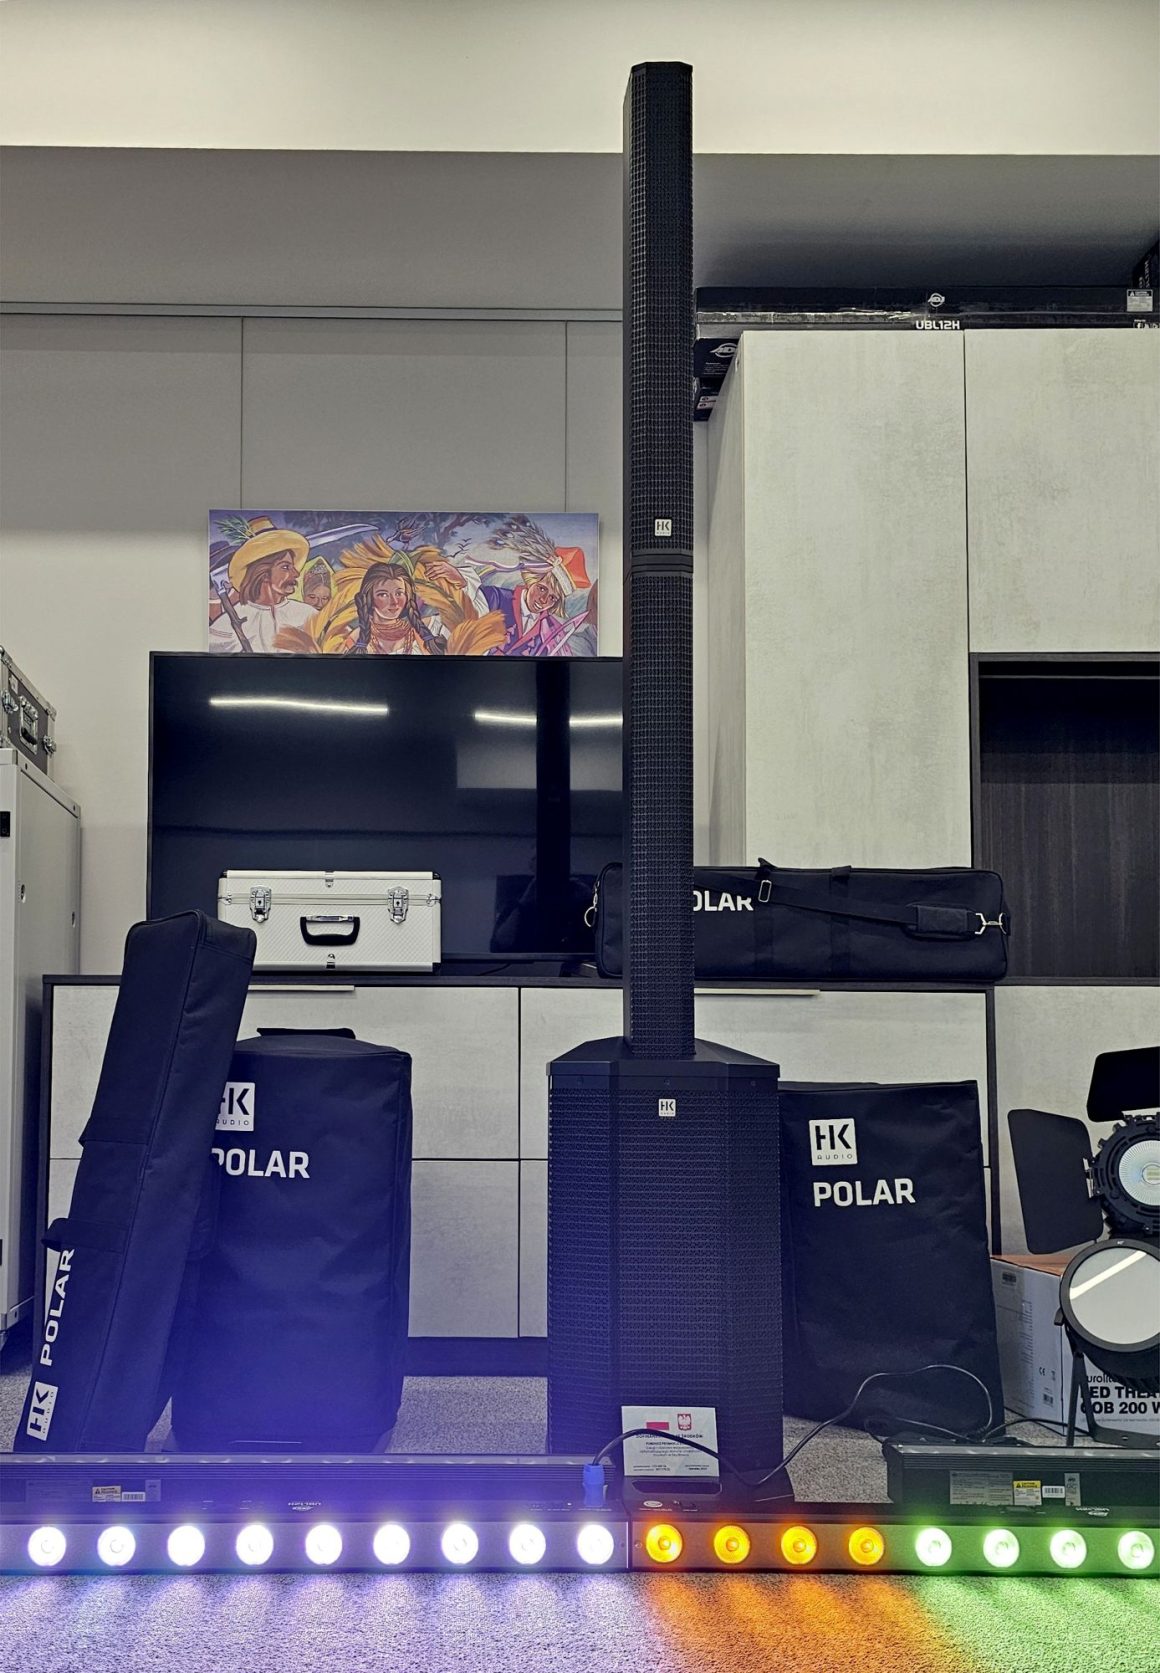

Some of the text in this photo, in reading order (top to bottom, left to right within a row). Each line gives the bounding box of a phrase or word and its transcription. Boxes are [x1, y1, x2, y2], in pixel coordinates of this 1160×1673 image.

[915, 320, 960, 330] UBL12H
[656, 521, 670, 531] HK
[693, 890, 754, 912] OLAR
[660, 1101, 674, 1111] HK
[815, 1124, 852, 1150] HK
[812, 1178, 916, 1207] POLAR
[29, 1248, 75, 1432] HK POLAR
[1081, 1386, 1111, 1399] ED
[1119, 1401, 1148, 1415] 200
